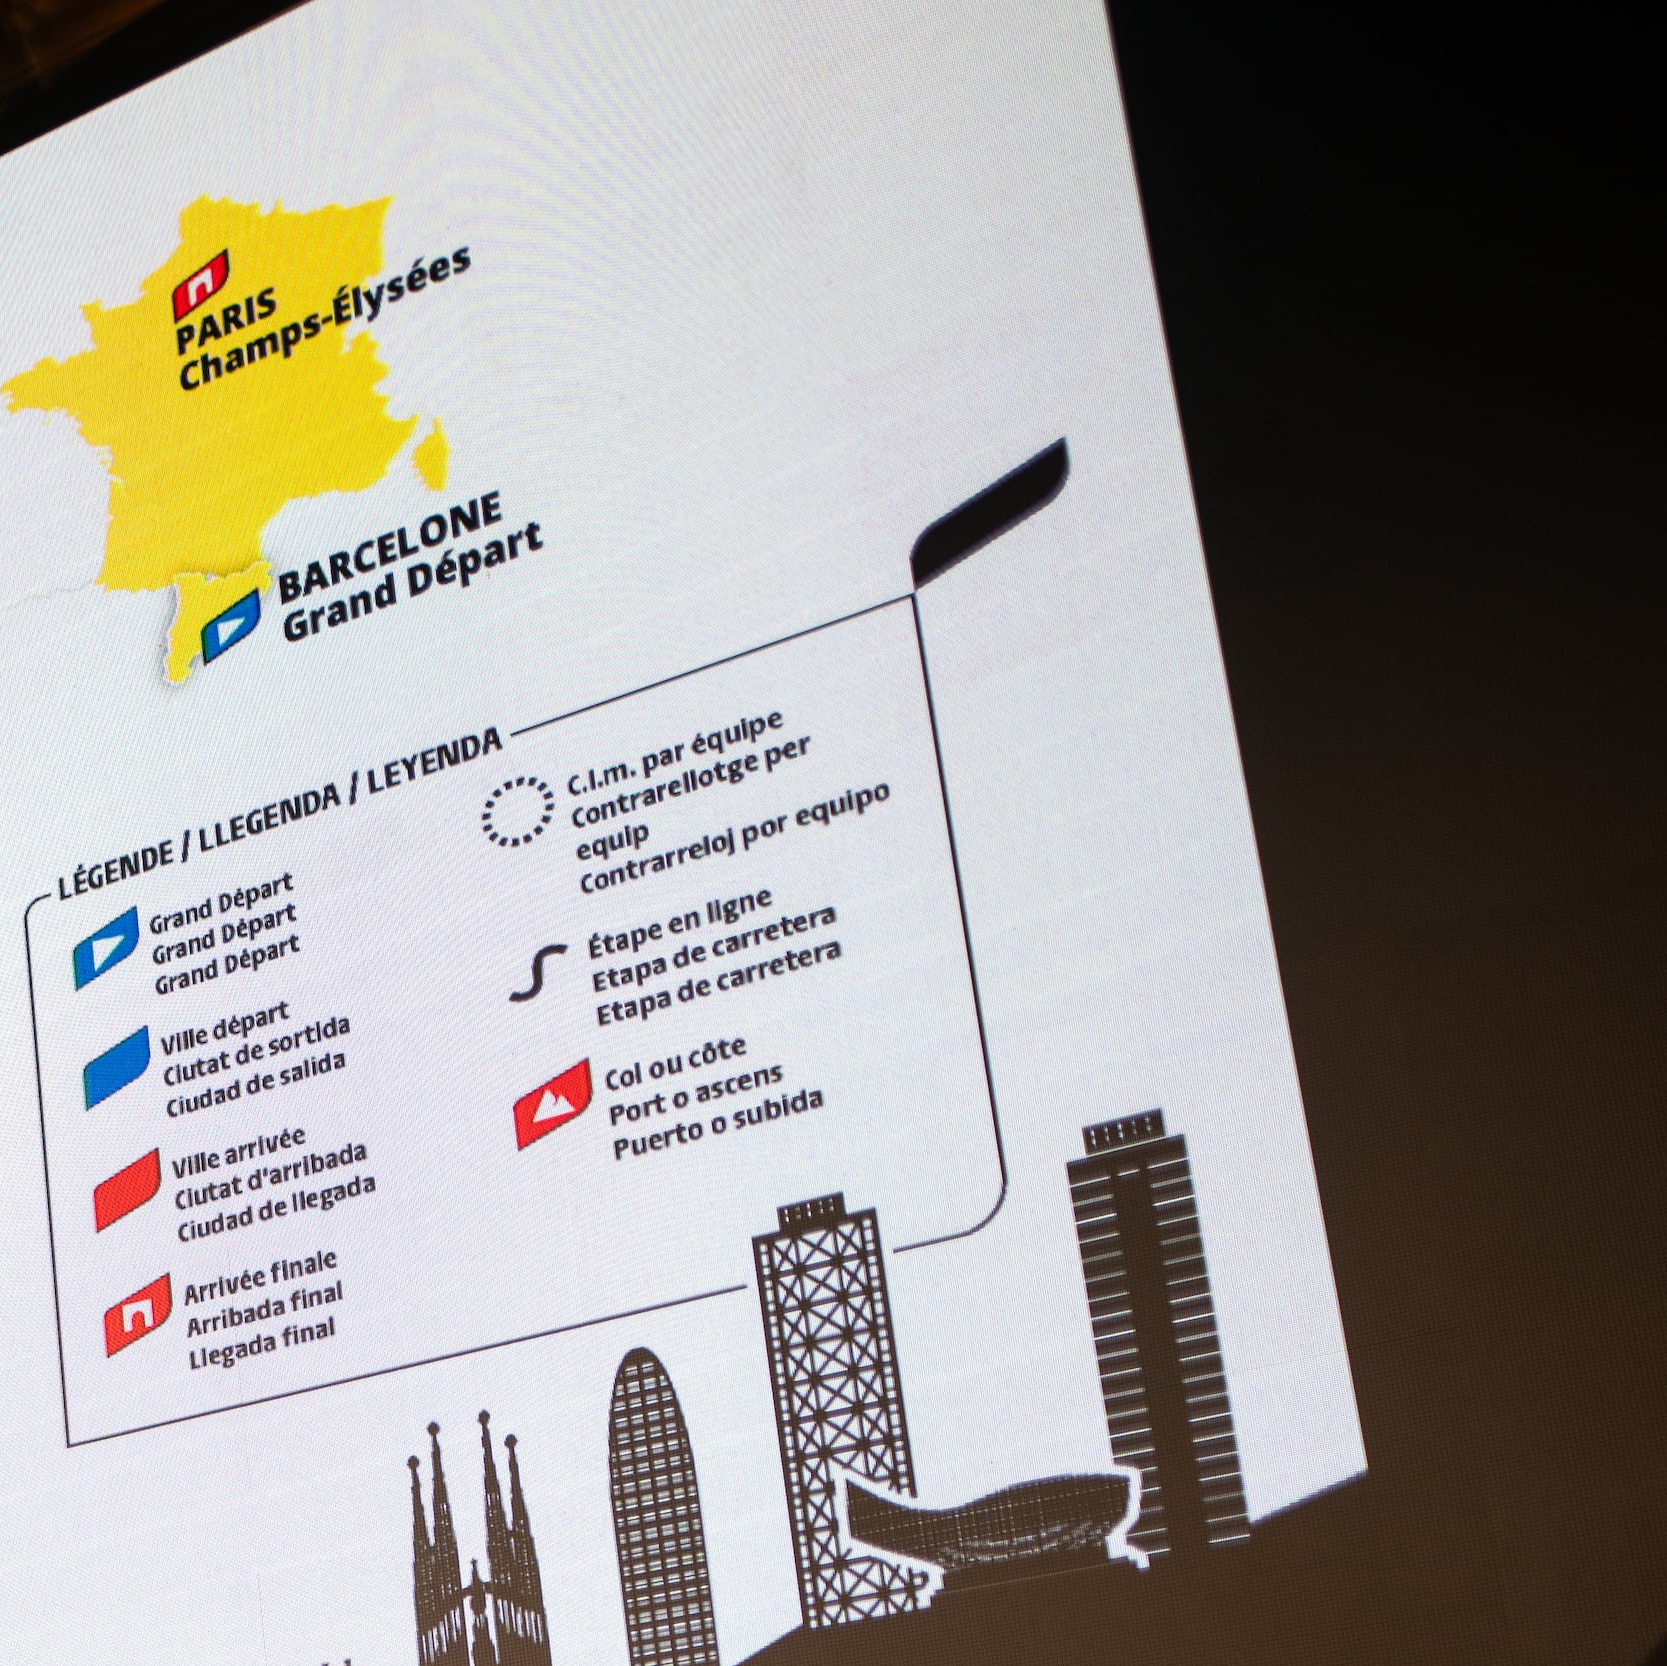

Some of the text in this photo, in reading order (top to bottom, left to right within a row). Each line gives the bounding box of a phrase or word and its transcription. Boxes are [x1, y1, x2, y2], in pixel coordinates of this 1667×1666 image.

[176, 288, 277, 355] PARIS
[179, 246, 470, 391] Champs-Élysées
[278, 491, 501, 604] BARCELONE
[283, 521, 544, 642] Grand Départ
[643, 743, 685, 779] par
[692, 710, 784, 756] équipe
[59, 727, 502, 900] LÉGENDE / LLEGENDA / LEYENDA
[572, 735, 811, 828] Contrarellotge per
[577, 823, 649, 861] equip
[581, 782, 890, 894] Contrarreloj por equipo
[150, 872, 293, 934] Grand Départ
[153, 903, 296, 965] Grand Départ
[589, 889, 772, 960] Étape en ligne
[155, 934, 300, 995] Grand Départ
[593, 906, 837, 992] Etapa de carretera
[597, 940, 842, 1026] Etapa de carretera
[161, 1001, 289, 1056] Ville départ
[164, 1015, 350, 1087] Ciutat de sortida
[606, 1035, 747, 1091] Col ou côte
[167, 1050, 346, 1119] Ciudad de salida
[610, 1063, 783, 1126] Port o ascens
[172, 1125, 306, 1179] Ville arrivée
[614, 1087, 823, 1160] Puerto o subida
[175, 1142, 367, 1211] Ciutat d'arribada
[178, 1174, 376, 1243] Ciudad de llegada
[184, 1251, 337, 1306] Arrivée finale
[187, 1280, 343, 1338] Arribada final
[190, 1317, 335, 1370] Llegada final
